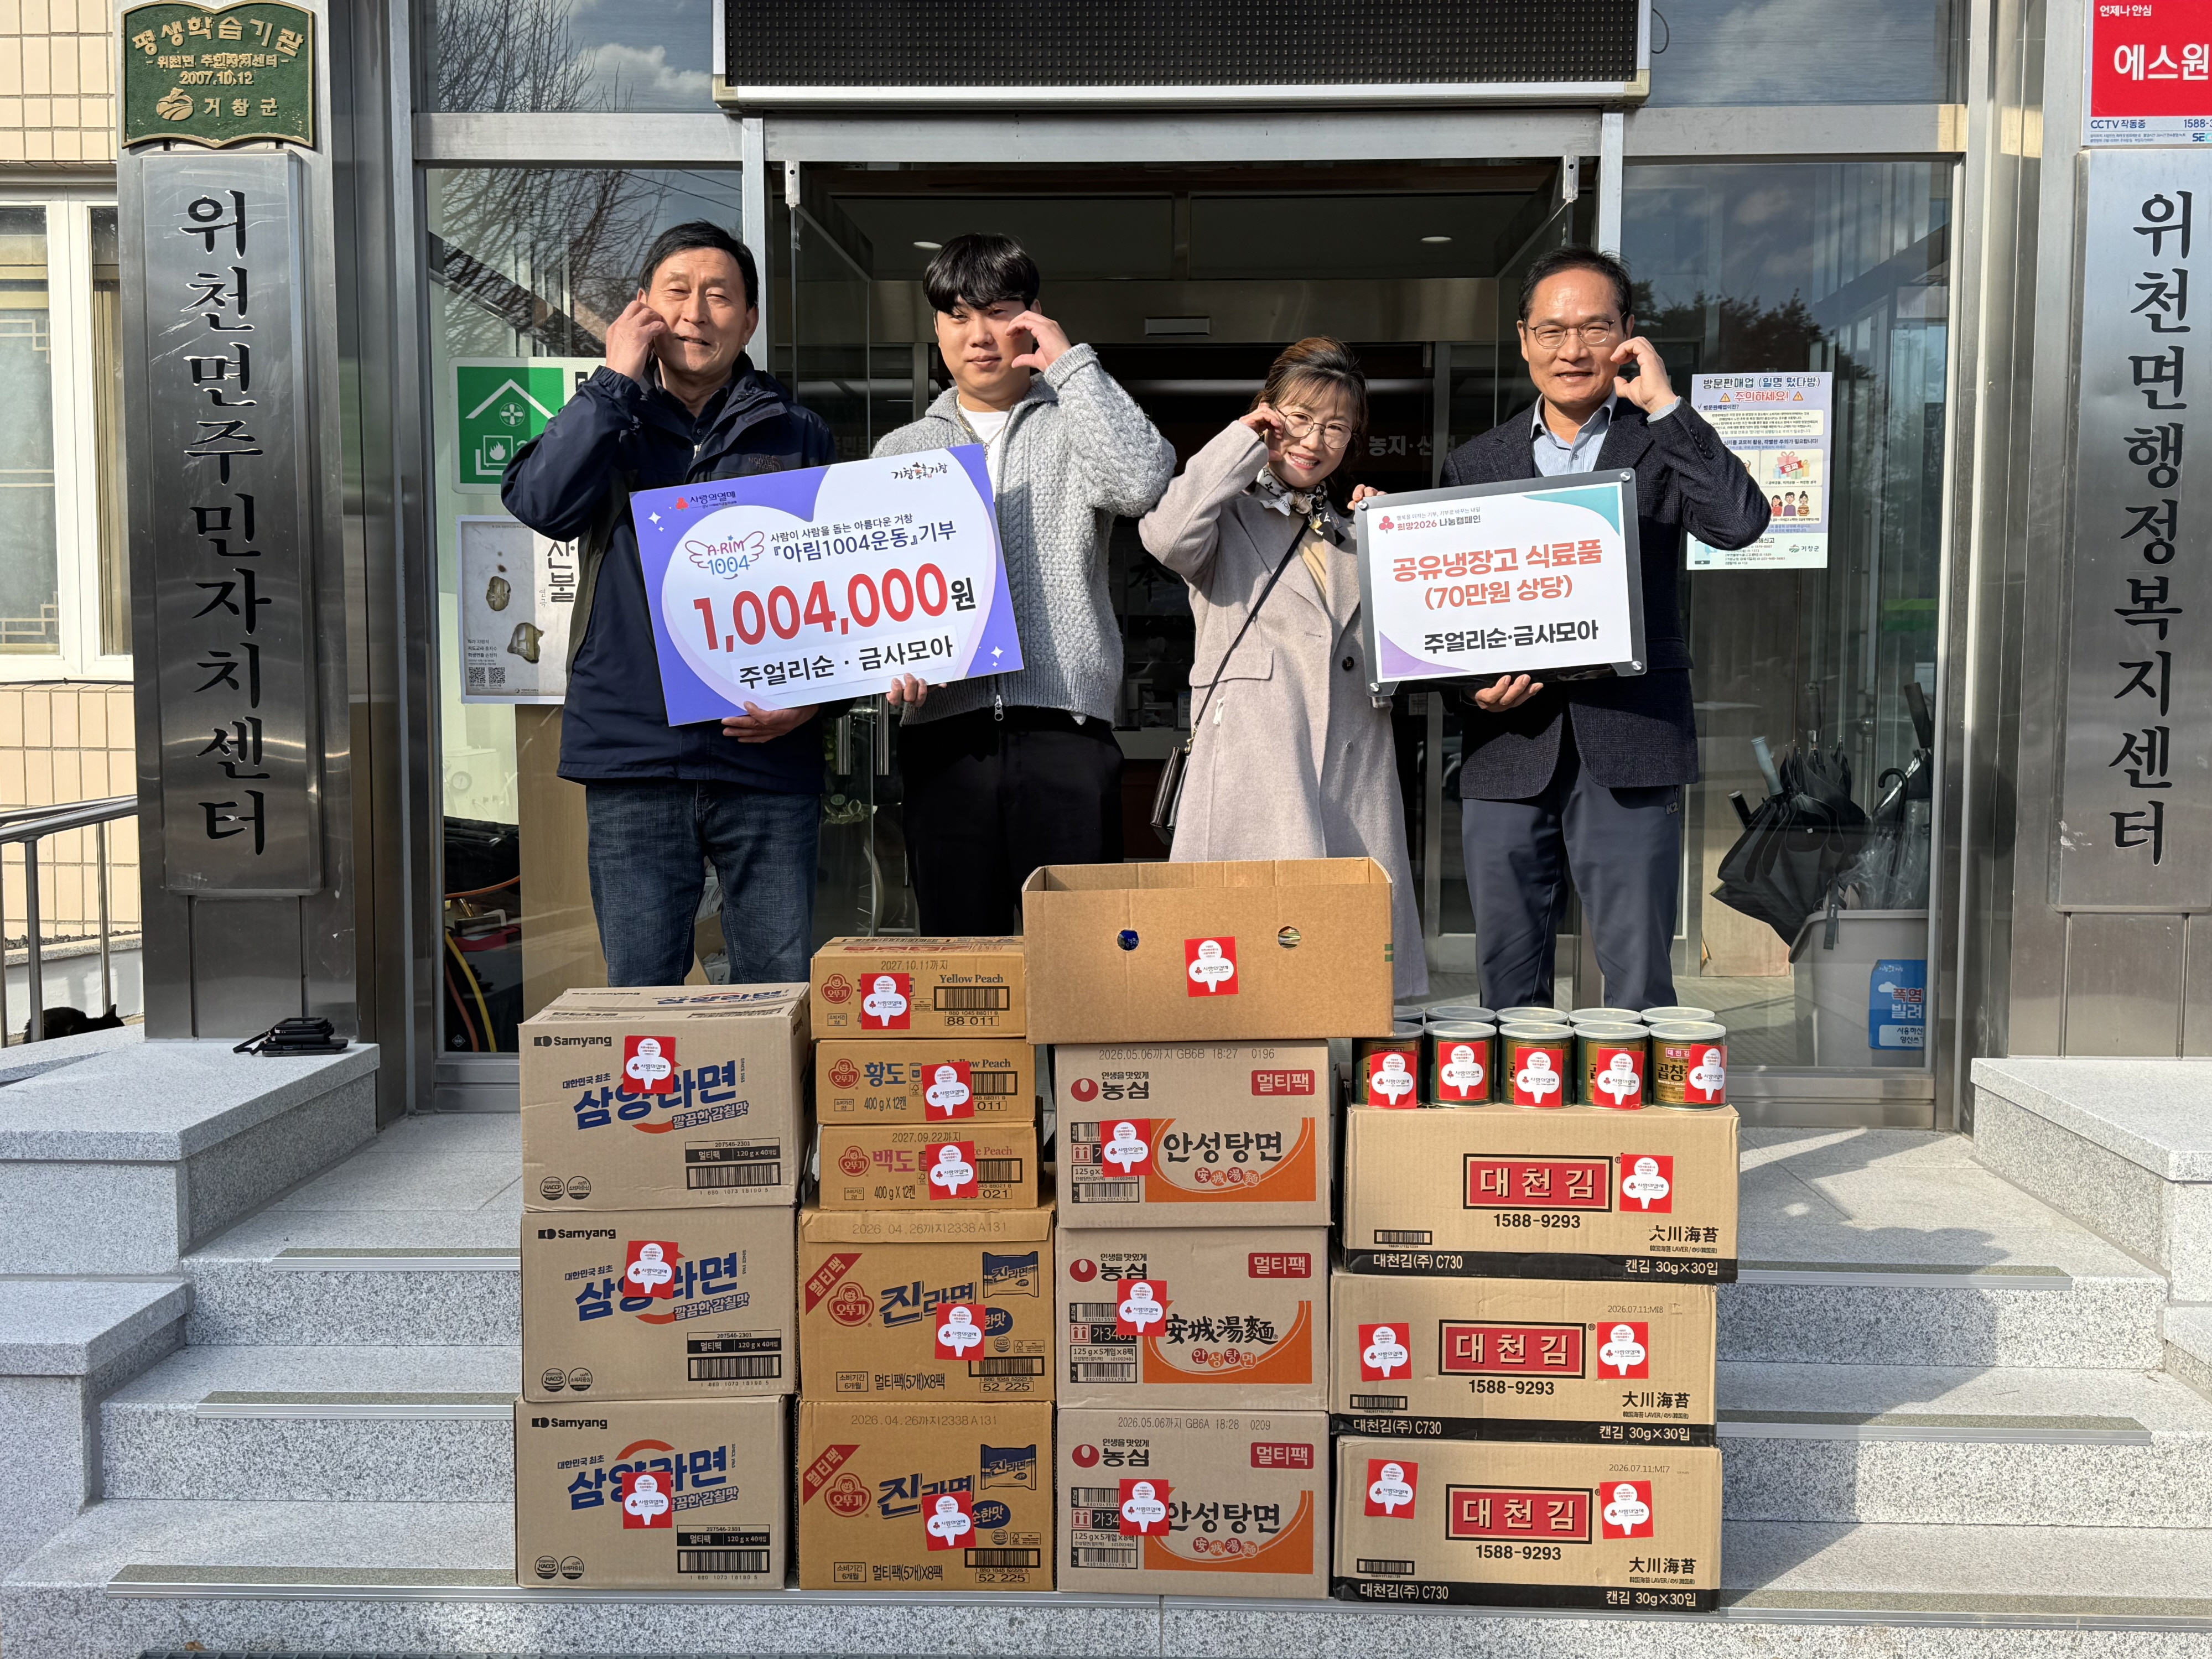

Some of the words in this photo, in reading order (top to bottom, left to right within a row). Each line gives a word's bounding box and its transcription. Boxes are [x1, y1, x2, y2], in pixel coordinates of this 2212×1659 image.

[2100, 5, 2130, 17] 언제나
[2132, 4, 2152, 17] 안심
[132, 16, 304, 57] 평생학습기관
[2114, 44, 2209, 81] 에스원
[180, 70, 254, 86] 2007.10.12
[2090, 120, 2119, 129] CCTV
[2121, 119, 2146, 128] 작동중
[2193, 133, 2212, 142] SEC
[1703, 378, 1754, 389] 방문판매업
[1758, 377, 1783, 388] (일명
[1734, 391, 1789, 402] 주의하세요!
[690, 491, 736, 504] 사랑의열매
[771, 531, 799, 543] 사람이
[802, 526, 830, 539] 사람을
[833, 523, 852, 535] 돕는
[854, 517, 892, 531] 아름다운
[894, 513, 913, 525] 거창
[1398, 520, 1437, 531] 희망2026
[1440, 515, 1481, 526] 나눔캠페인
[707, 554, 750, 575] 1004
[1393, 548, 1518, 582] 공유냉장고
[1525, 539, 1602, 569] 식료품
[1425, 581, 1510, 610] (70만원
[1518, 574, 1572, 599] 상당)
[693, 563, 976, 652] 1,004,000원
[739, 654, 834, 690] 주얼리순
[859, 635, 953, 670] 금사모아
[881, 960, 948, 970] 2027.10.11까지
[939, 975, 973, 984] Yellow
[974, 975, 1004, 984] Peach
[554, 1036, 612, 1047] Samyang
[1099, 1049, 1173, 1060] 2026.05.06까지
[1212, 1049, 1238, 1059] 18:27
[1252, 1049, 1275, 1059] 0196
[982, 1059, 1011, 1068] Peach
[563, 1076, 594, 1089] 대한민국
[595, 1073, 611, 1082] 최초
[864, 1062, 906, 1087] 황도
[1101, 1072, 1124, 1080] 인생을
[1125, 1071, 1149, 1079] 맛있게
[1257, 1073, 1309, 1092] 멀티팩
[1102, 1081, 1149, 1100] 농심
[864, 1097, 877, 1109] 400
[892, 1096, 906, 1110] 12캔
[672, 1109, 710, 1130] 깔끔한
[711, 1100, 749, 1122] 감칠맛
[892, 1131, 961, 1143] 2027.09.22까지
[699, 1150, 720, 1160] 멀티팩
[984, 1147, 1012, 1156] Peach
[1164, 1131, 1283, 1163] 안성탕면
[845, 1161, 864, 1169] 오뚜기
[873, 1149, 916, 1173] 백도
[874, 1186, 887, 1199] 400
[902, 1185, 916, 1199] 12캔
[1494, 1214, 1581, 1229] 1588-9293
[558, 1229, 616, 1240] Samyang
[1649, 1225, 1718, 1243] 大川海苔
[1100, 1254, 1123, 1262] 인생을
[1124, 1253, 1147, 1262] 맛있게
[1254, 1256, 1306, 1275] 멀티팩
[1373, 1253, 1433, 1268] 대천김(주)
[1436, 1255, 1463, 1269] C730
[564, 1268, 596, 1281] 대한민국
[597, 1265, 613, 1273] 최초
[1100, 1263, 1147, 1281] 농심
[1625, 1259, 1650, 1273] 캔김
[808, 1257, 846, 1297] 멀티팩
[992, 1266, 1028, 1283] 진라면
[674, 1300, 711, 1320] 깔끔한
[710, 1292, 749, 1314] 감칠맛
[837, 1303, 866, 1315] 오뚜기
[701, 1341, 721, 1351] 멀티팩
[1005, 1383, 1030, 1391] 225
[1469, 1380, 1555, 1395] 1588-9293
[1622, 1391, 1690, 1408] 大川海苔
[551, 1418, 607, 1429] Samyang
[1118, 1417, 1182, 1429] 2026.05.06까지
[1186, 1418, 1210, 1429] GB6A
[1216, 1419, 1239, 1429] 18:28
[1250, 1420, 1271, 1431] 0209
[1353, 1418, 1412, 1435] 대천김(주)
[1415, 1421, 1441, 1436] C730
[1600, 1425, 1624, 1439] 캔김
[1103, 1438, 1125, 1447] 인생을
[1126, 1439, 1149, 1447] 맛있게
[557, 1457, 588, 1470] 대한민국
[589, 1455, 604, 1463] 최초
[1102, 1448, 1149, 1467] 농심
[1256, 1447, 1308, 1465] 멀티팩
[806, 1447, 843, 1486] 멀티팩
[702, 1486, 739, 1507] 감칠맛
[833, 1495, 863, 1506] 오뚜기
[972, 1505, 1004, 1525] 순한맛
[1169, 1501, 1281, 1533] 안성탕면
[690, 1534, 710, 1544] 멀티팩
[1476, 1545, 1561, 1561] 1588-9293
[1629, 1557, 1696, 1575] 大川海苔
[979, 1574, 995, 1582] 52
[1001, 1574, 1025, 1582] 225
[1359, 1582, 1419, 1599] 대천김(주)
[1422, 1585, 1448, 1600] C730
[1606, 1591, 1631, 1605] 캔김
